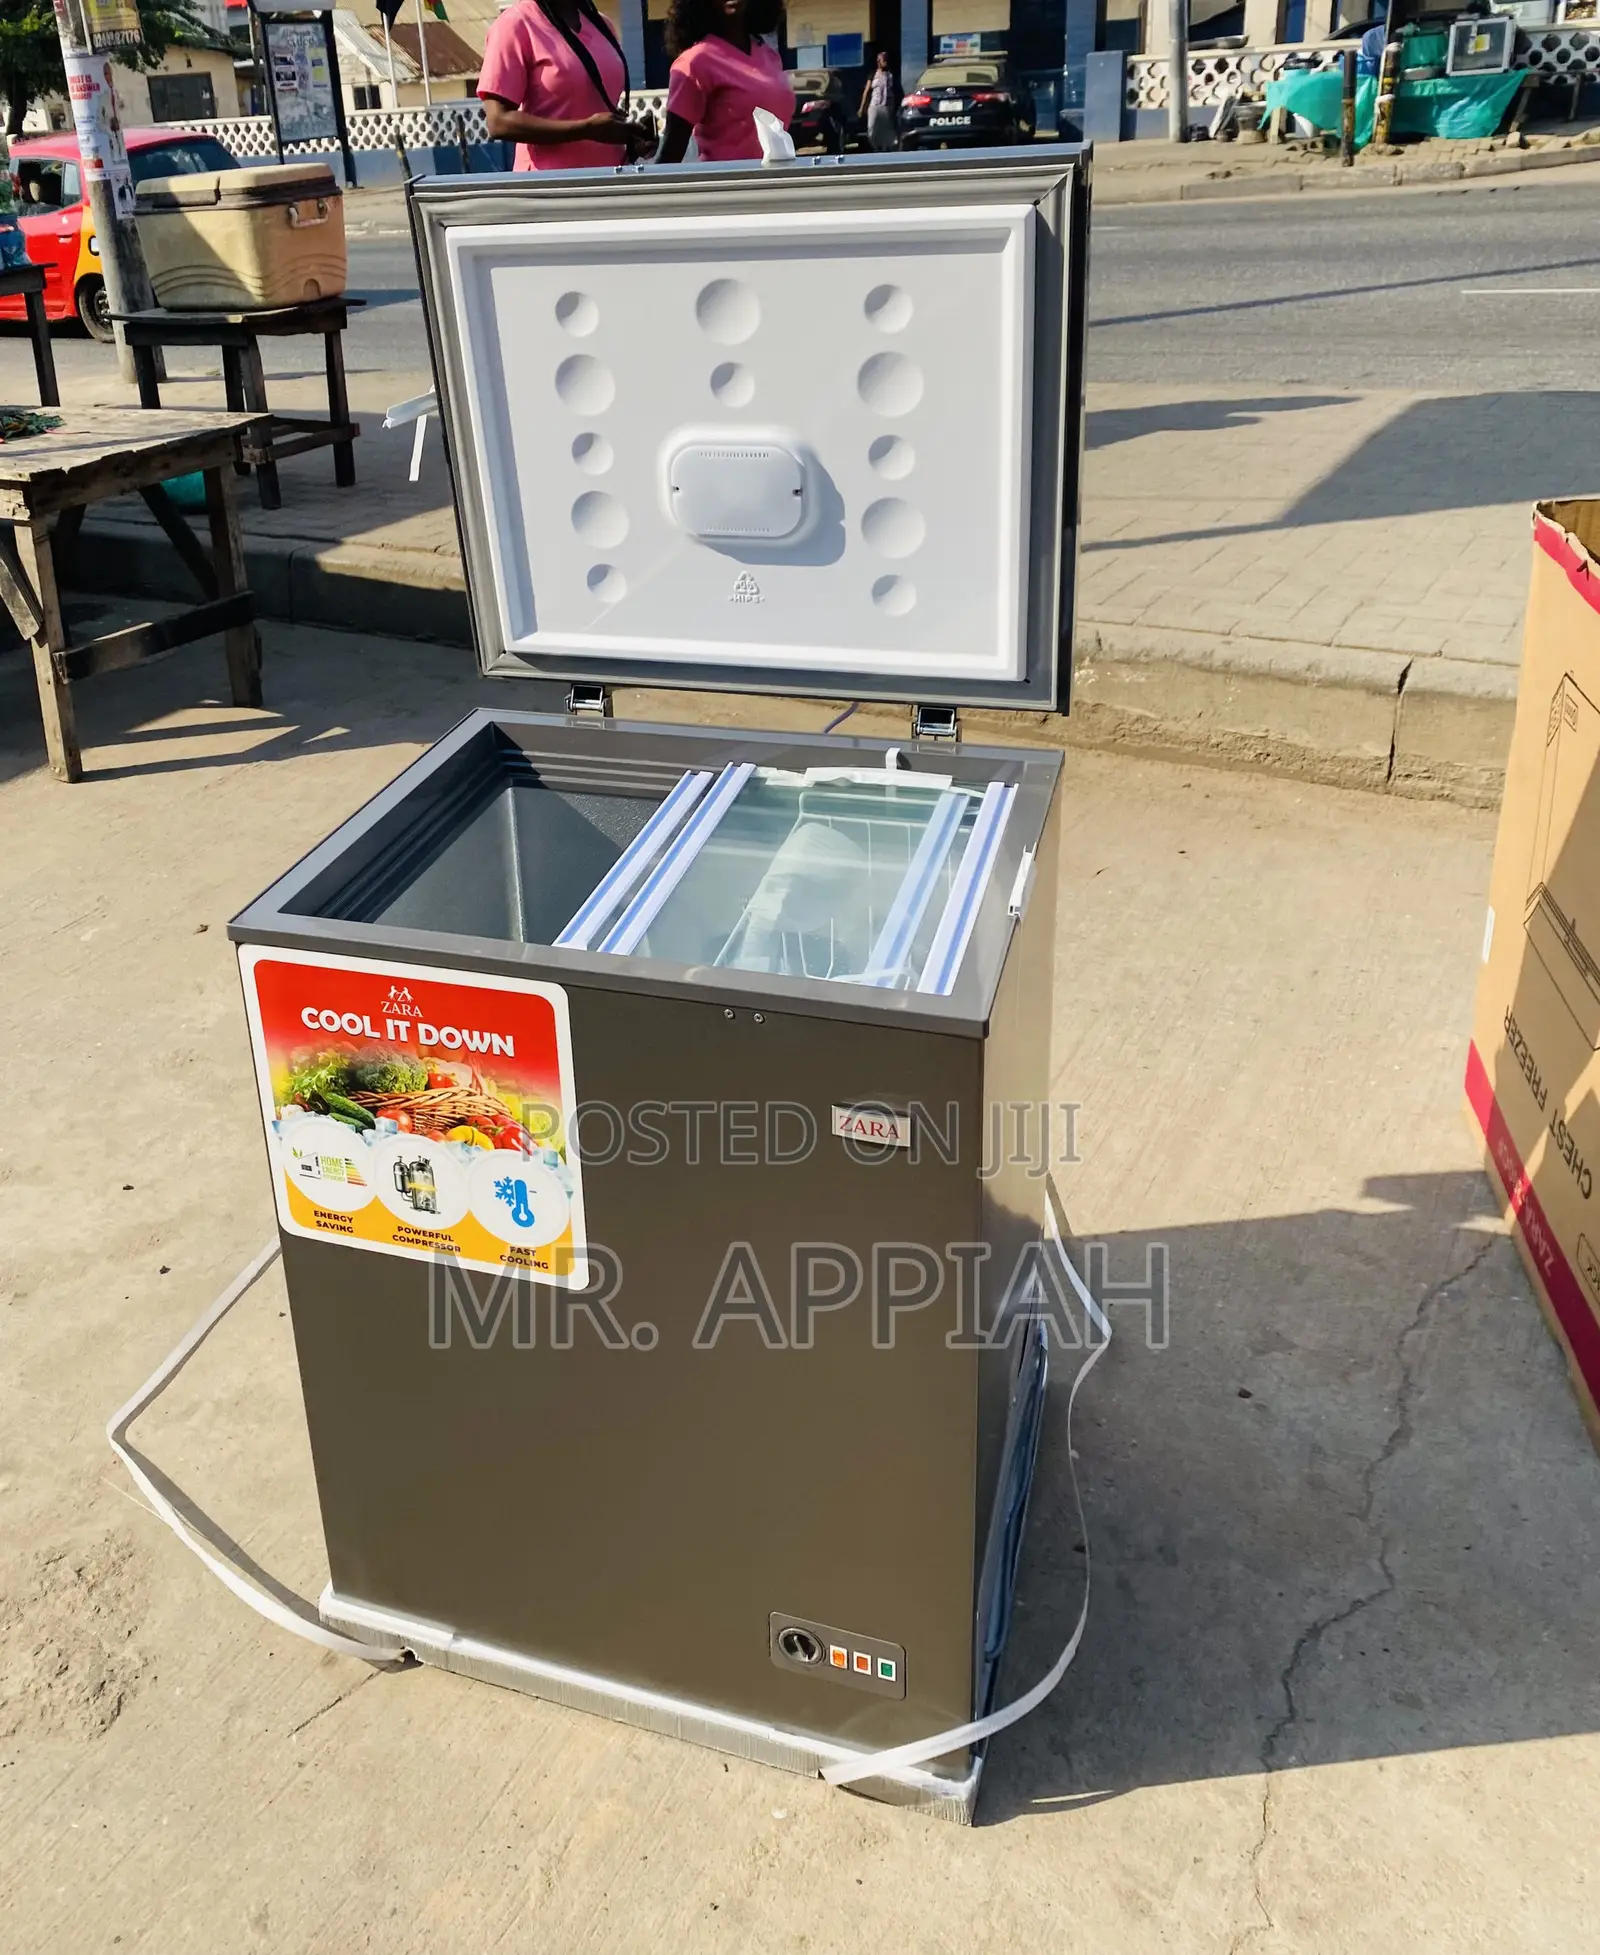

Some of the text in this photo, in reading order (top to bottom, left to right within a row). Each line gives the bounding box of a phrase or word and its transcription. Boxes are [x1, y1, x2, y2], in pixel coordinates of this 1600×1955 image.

[929, 116, 971, 127] POLICE
[381, 1001, 423, 1017] ZARA
[301, 1006, 515, 1057] COOL IT DOWN
[1504, 1004, 1547, 1112] FREEZER
[839, 1115, 900, 1139] ZARA
[320, 1156, 344, 1168] HOME
[1549, 1108, 1592, 1200] CHEST
[314, 1210, 353, 1224] ENERGY
[316, 1220, 354, 1233] SAVING
[397, 1226, 454, 1242] POWERFUL
[392, 1234, 461, 1253] COMPRESSOR
[510, 1246, 536, 1257] FAST
[500, 1254, 549, 1270] COOLING
